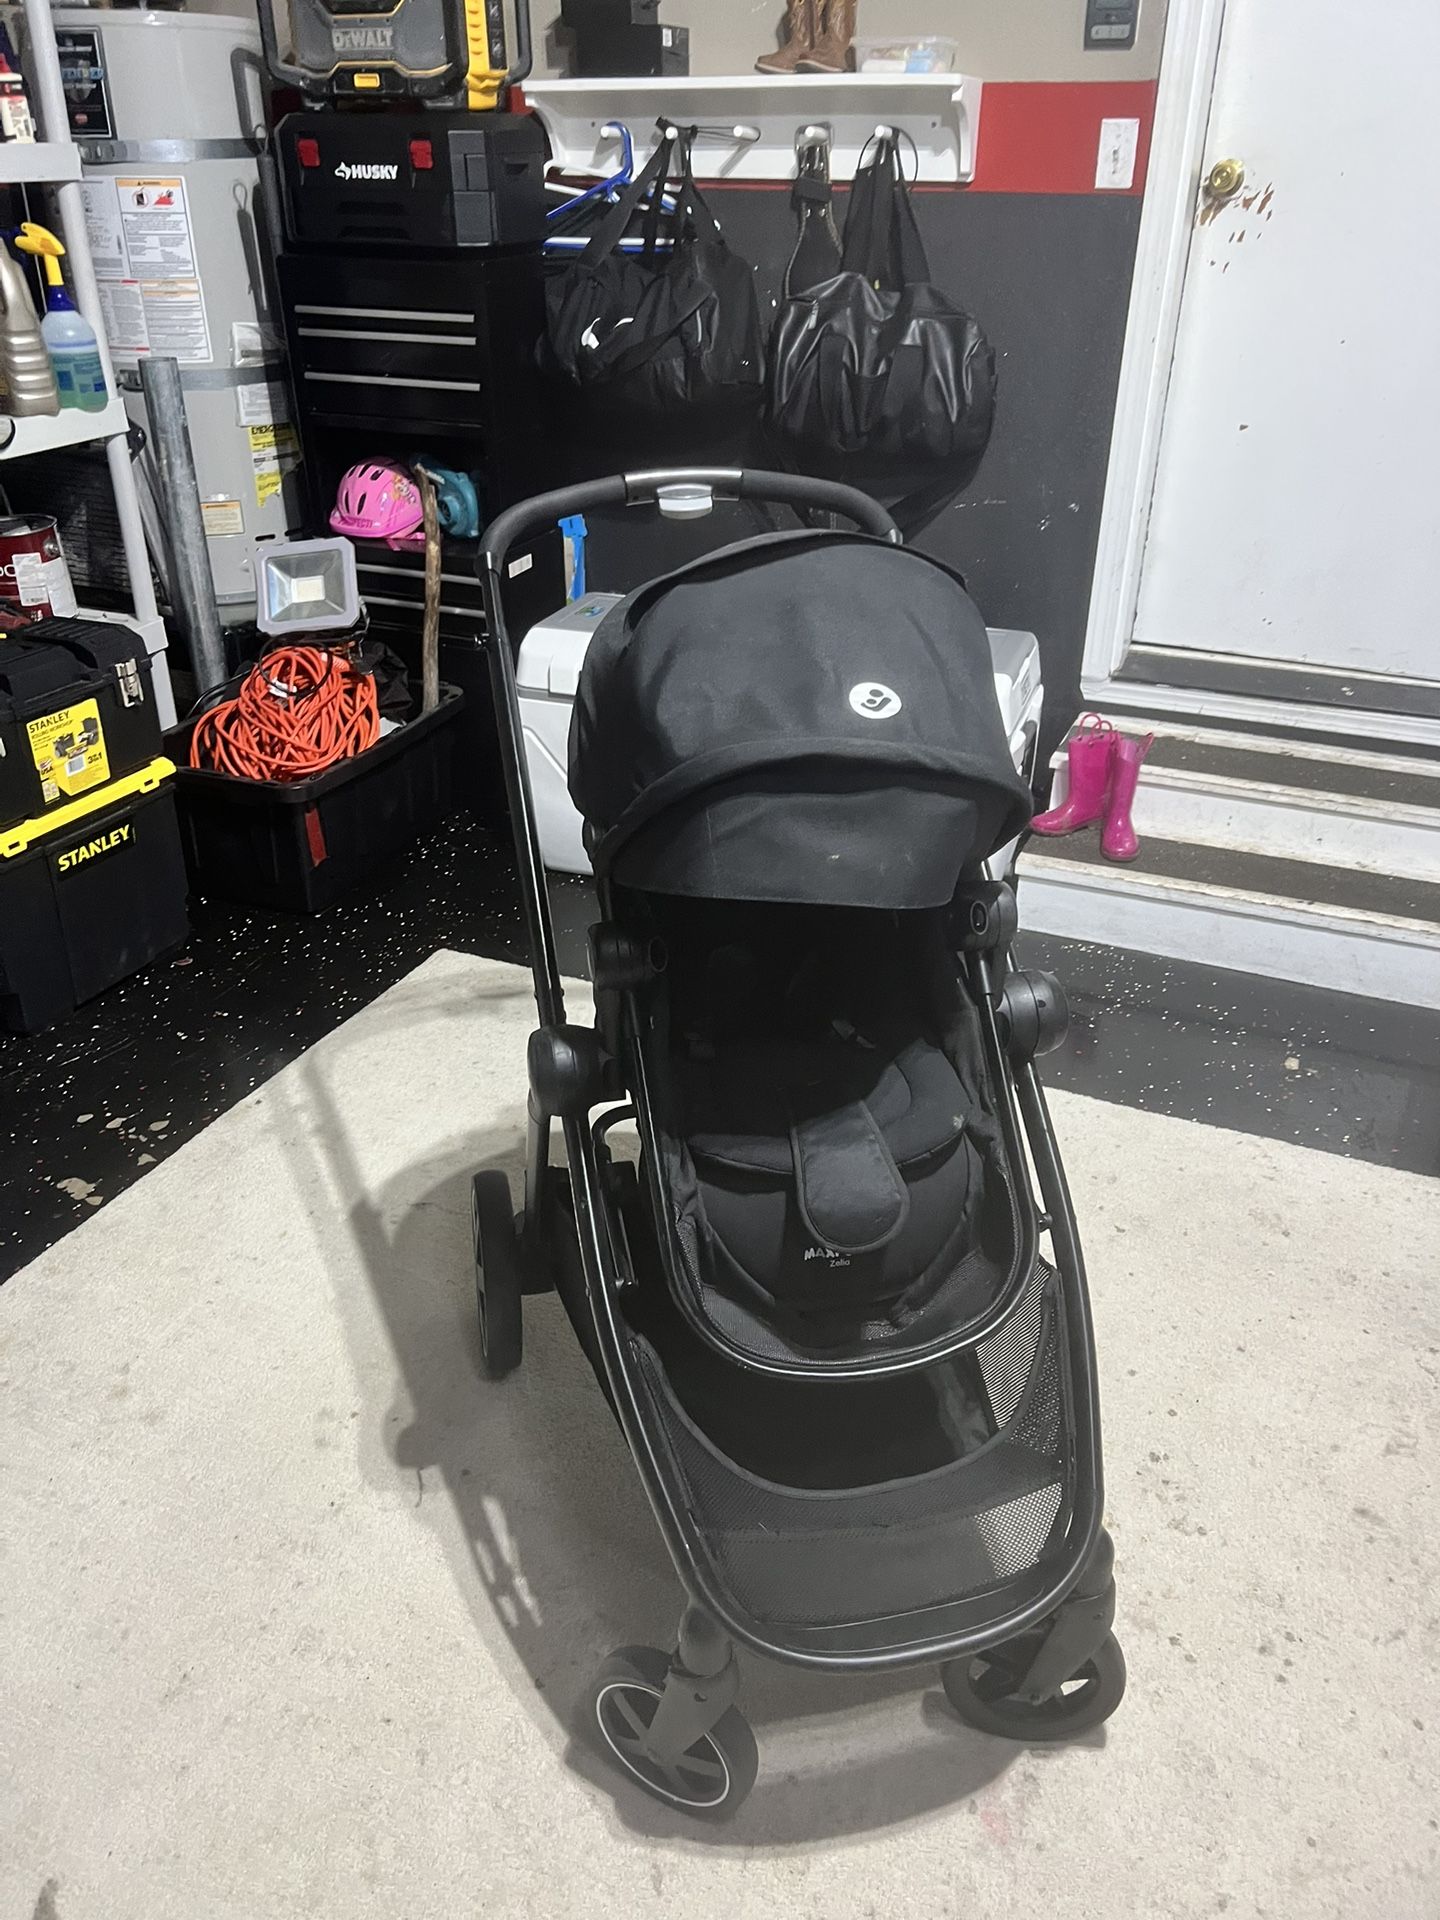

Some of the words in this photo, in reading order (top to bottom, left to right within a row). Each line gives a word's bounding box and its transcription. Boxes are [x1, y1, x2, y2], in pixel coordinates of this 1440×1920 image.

[332, 28, 393, 49] DEWALT
[351, 164, 398, 180] HUSKY
[29, 710, 70, 733] STANLEY
[58, 823, 130, 872] STANLEY
